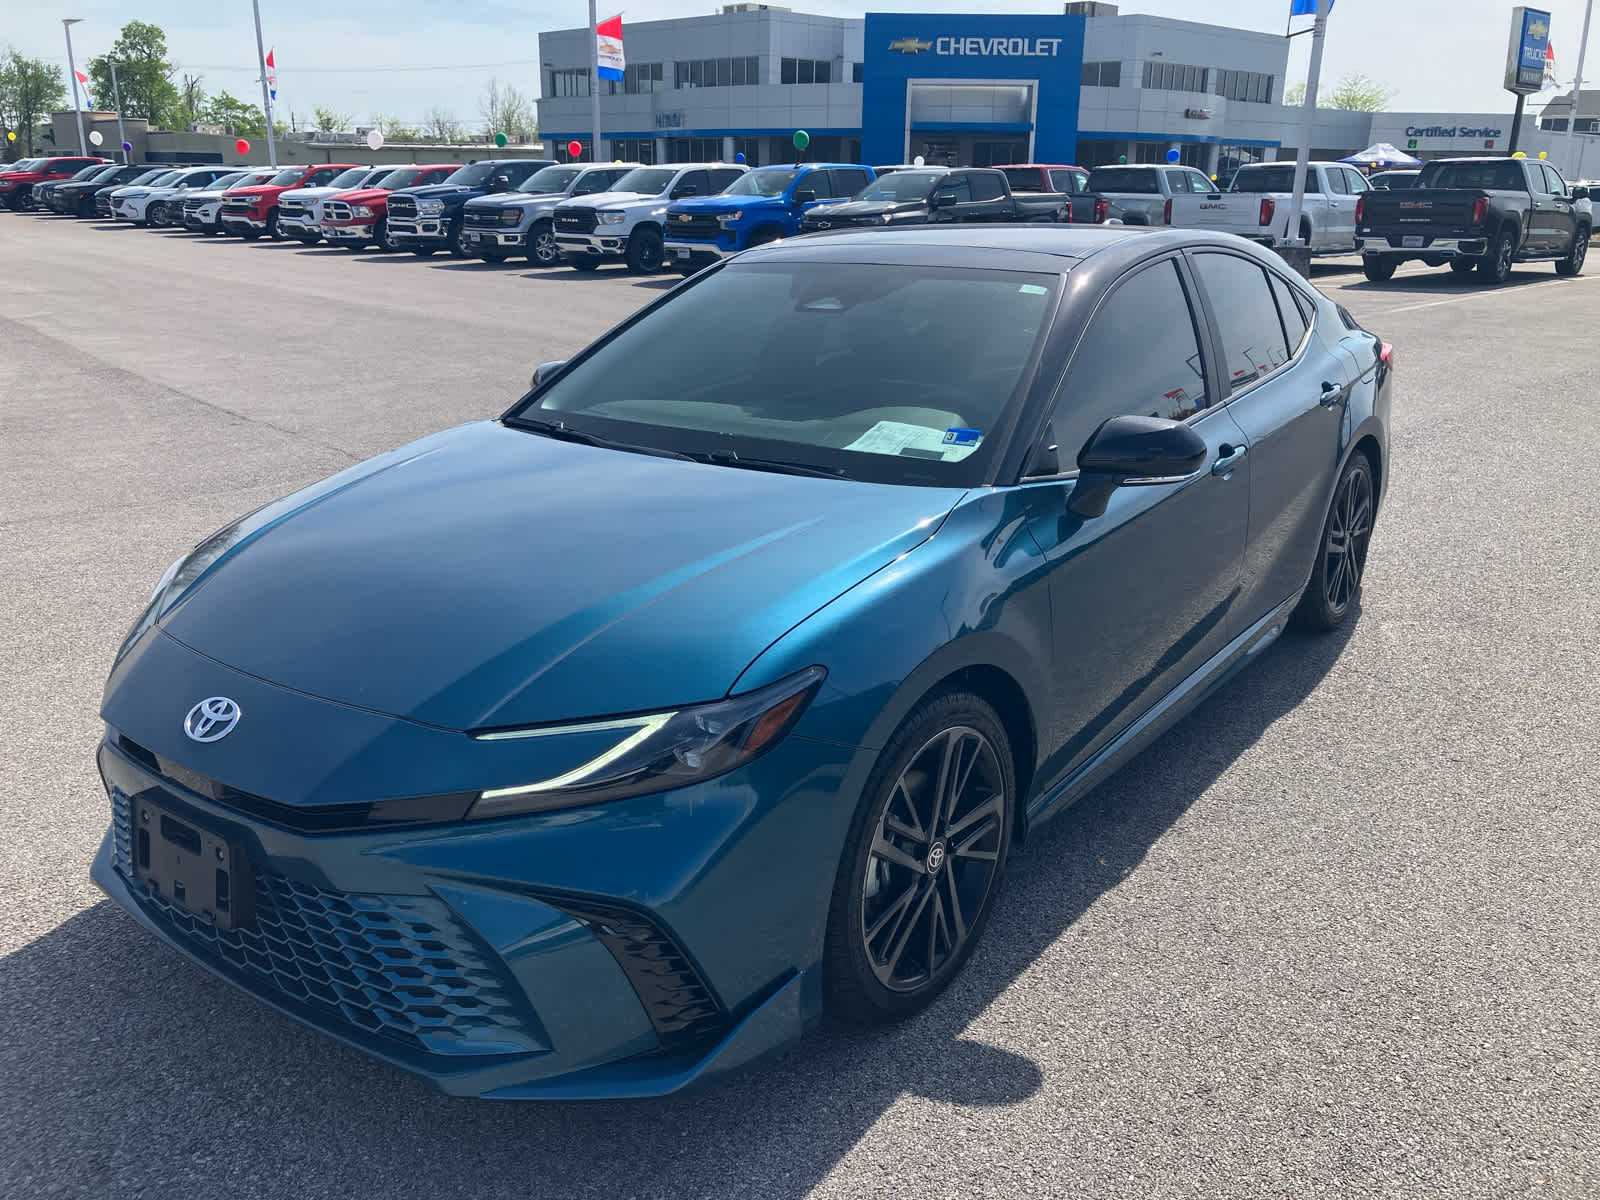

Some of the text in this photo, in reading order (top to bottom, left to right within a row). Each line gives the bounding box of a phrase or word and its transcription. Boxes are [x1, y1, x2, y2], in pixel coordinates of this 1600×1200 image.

[936, 37, 1063, 56] CHEVROLET
[599, 54, 622, 62] VROLET
[1523, 46, 1546, 61] TRUCKS
[1406, 126, 1501, 138] Certified Service
[946, 432, 954, 441] 3
